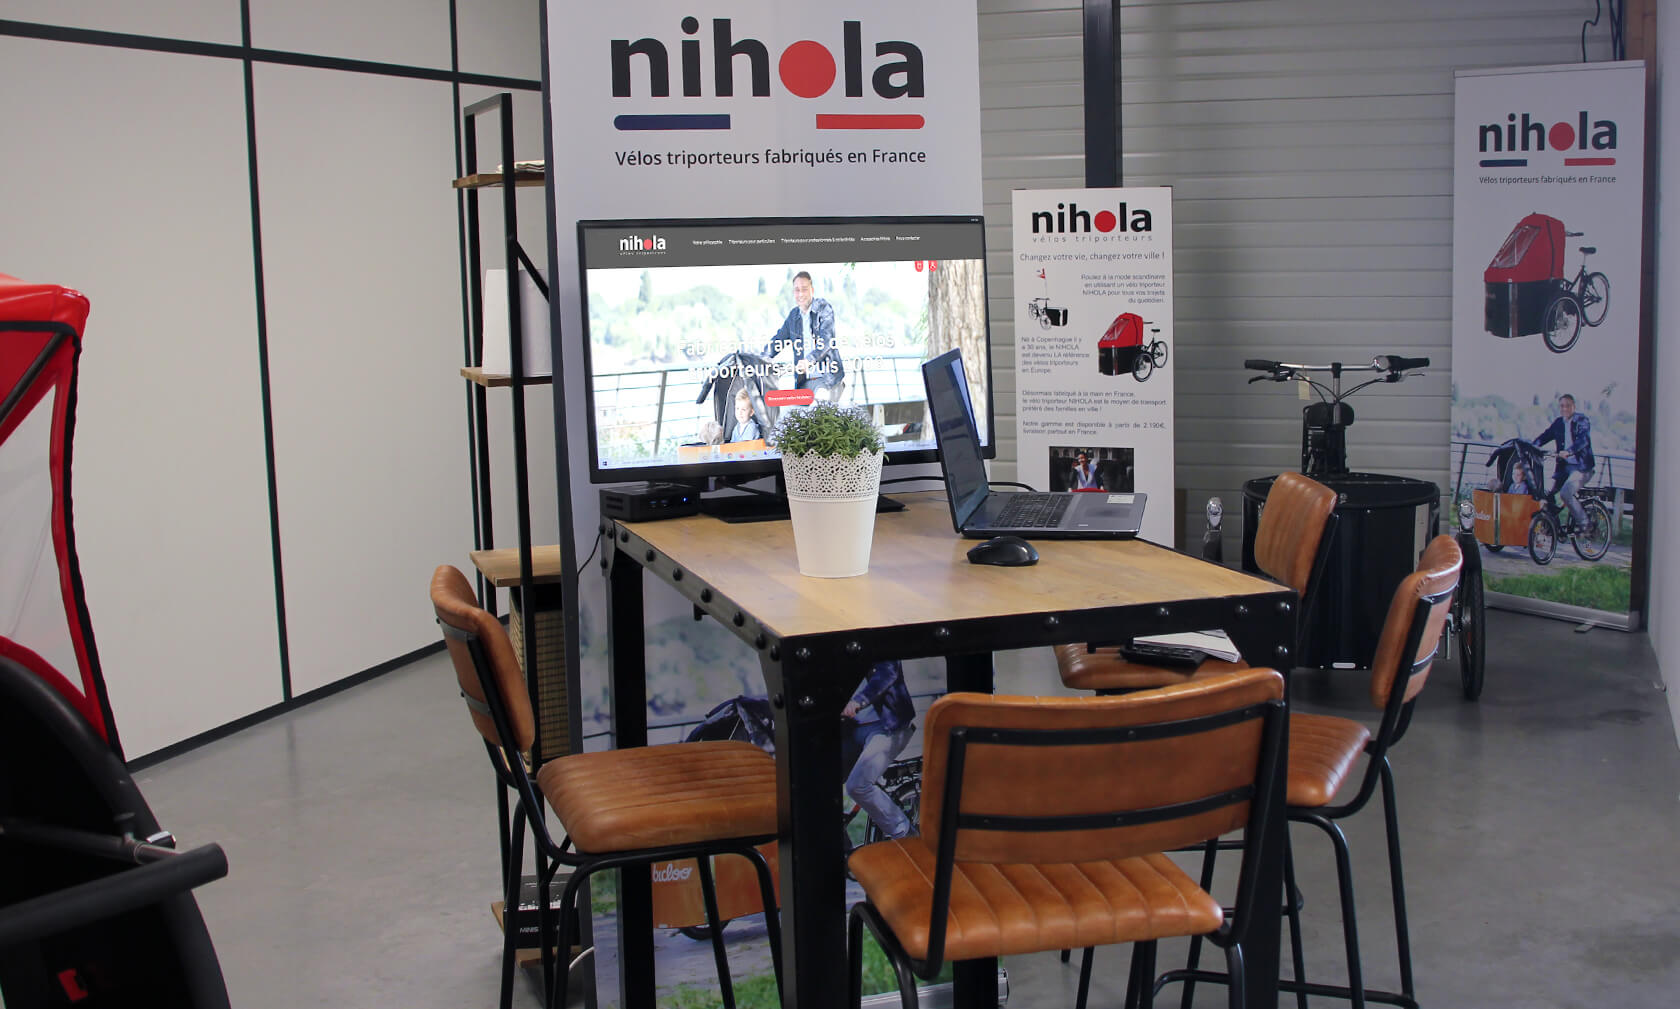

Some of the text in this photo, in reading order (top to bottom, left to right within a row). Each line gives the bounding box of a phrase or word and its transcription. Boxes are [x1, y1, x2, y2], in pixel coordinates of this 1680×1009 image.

[611, 16, 925, 99] nihola
[1479, 111, 1617, 152] nihola
[615, 149, 926, 168] Vélos triporteurs fabriqués en France
[1479, 175, 1498, 184] Vélos
[1499, 176, 1539, 185] triporteurs
[1540, 175, 1577, 185] fabriqués
[1590, 175, 1617, 183] France
[1032, 202, 1152, 233] nihola
[619, 235, 667, 251] nihola
[1032, 234, 1153, 243] vélos triporteurs
[1019, 253, 1051, 262] Changez
[1052, 253, 1073, 261] votre
[1074, 252, 1088, 262] vie,
[1089, 251, 1121, 262] changez
[1122, 252, 1143, 260] votre
[1143, 251, 1160, 260] ville
[1114, 273, 1131, 281] mode
